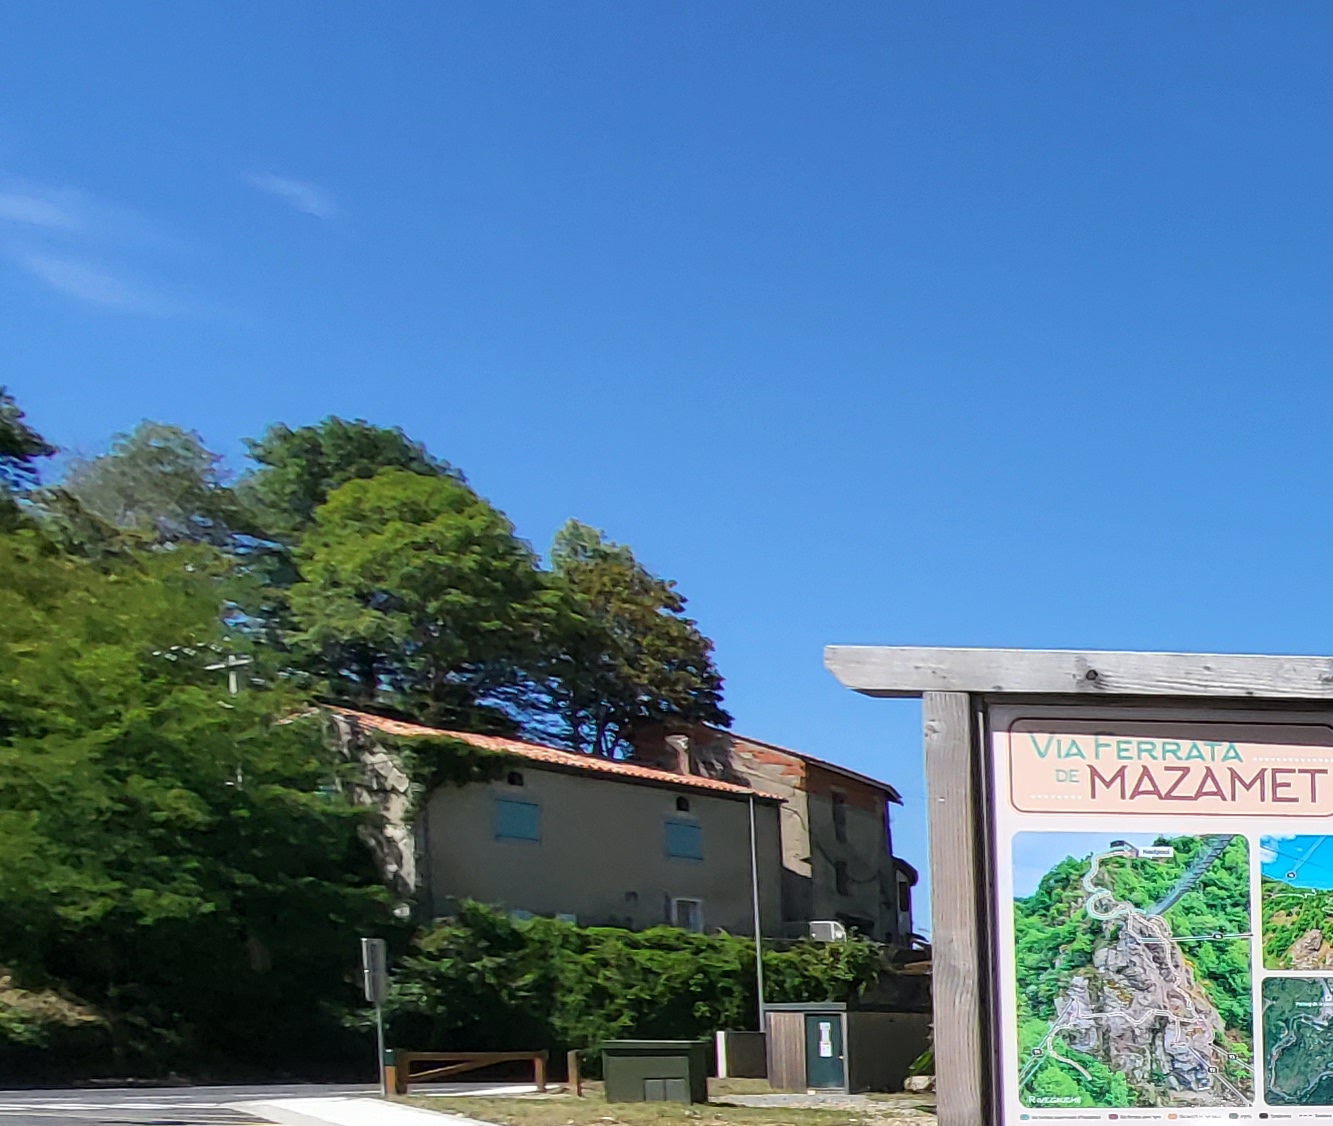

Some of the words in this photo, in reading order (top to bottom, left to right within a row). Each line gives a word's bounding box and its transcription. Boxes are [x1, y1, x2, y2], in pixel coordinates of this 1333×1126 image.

[1028, 731, 1087, 760] VIA
[1094, 732, 1243, 763] FERRATA
[1055, 769, 1080, 783] DE
[1086, 764, 1328, 803] MAZAMET
